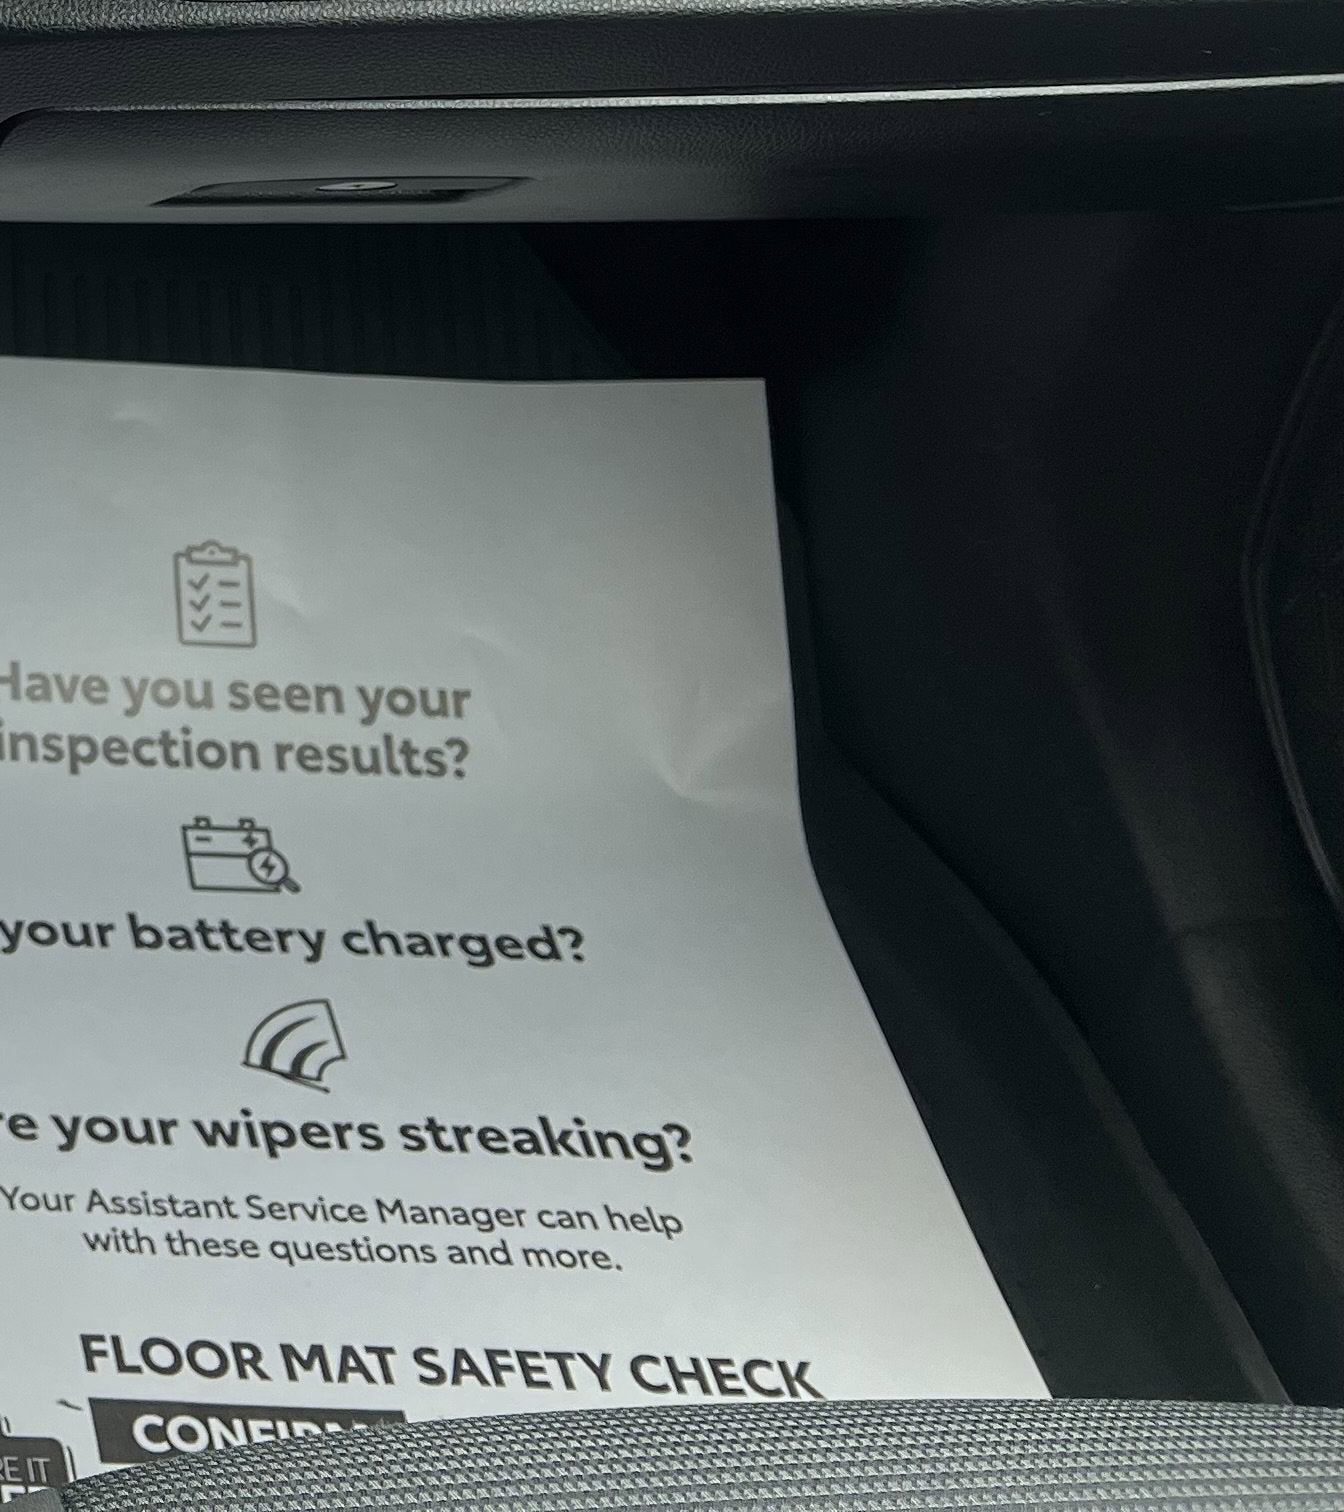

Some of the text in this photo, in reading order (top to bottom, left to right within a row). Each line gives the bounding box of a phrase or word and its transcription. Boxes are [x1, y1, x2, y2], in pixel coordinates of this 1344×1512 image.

[120, 676, 214, 718] you
[228, 680, 345, 714] seen
[356, 686, 471, 726] your
[275, 733, 469, 779] results?
[127, 912, 325, 963] battery
[342, 920, 584, 968] charged?
[51, 1115, 178, 1152] your
[192, 1108, 384, 1159] wipers
[399, 1115, 692, 1172] streaking?
[86, 1189, 239, 1219] Assistant
[245, 1195, 368, 1223] Service
[375, 1198, 526, 1233] Manager
[537, 1210, 599, 1230] can
[603, 1204, 683, 1240] help
[82, 1227, 622, 1270] with these questions and more.
[80, 1334, 825, 1400] FLOOR MAT SAFETY CHECK
[27, 1457, 51, 1483] IT
